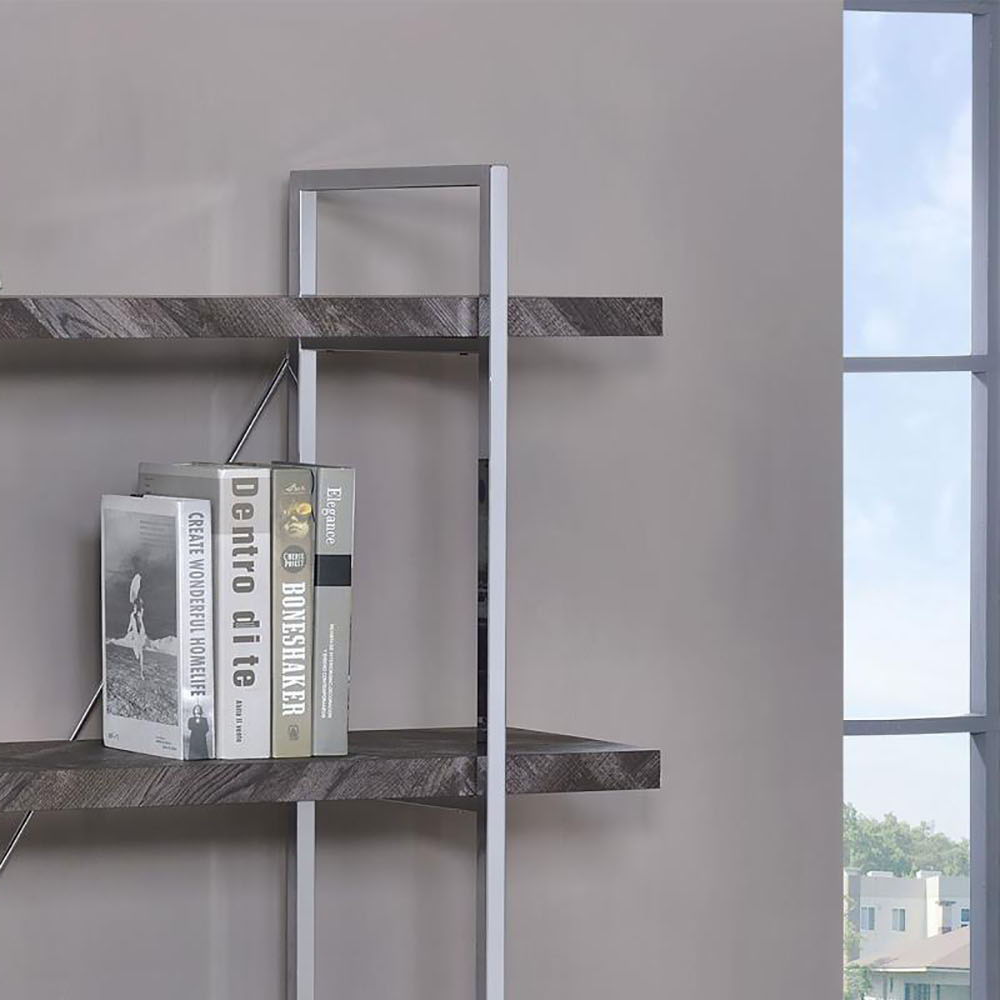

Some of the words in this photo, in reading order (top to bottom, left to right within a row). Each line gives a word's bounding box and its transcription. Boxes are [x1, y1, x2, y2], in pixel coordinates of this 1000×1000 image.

[188, 511, 205, 555] CREATE
[231, 477, 259, 594] Dentro
[321, 486, 342, 545] Elegance
[188, 558, 206, 634] WONDERFUL
[232, 610, 260, 644] di
[281, 581, 306, 716] BONESHAKER
[189, 636, 207, 697] HOMELIFE
[232, 655, 260, 687] te
